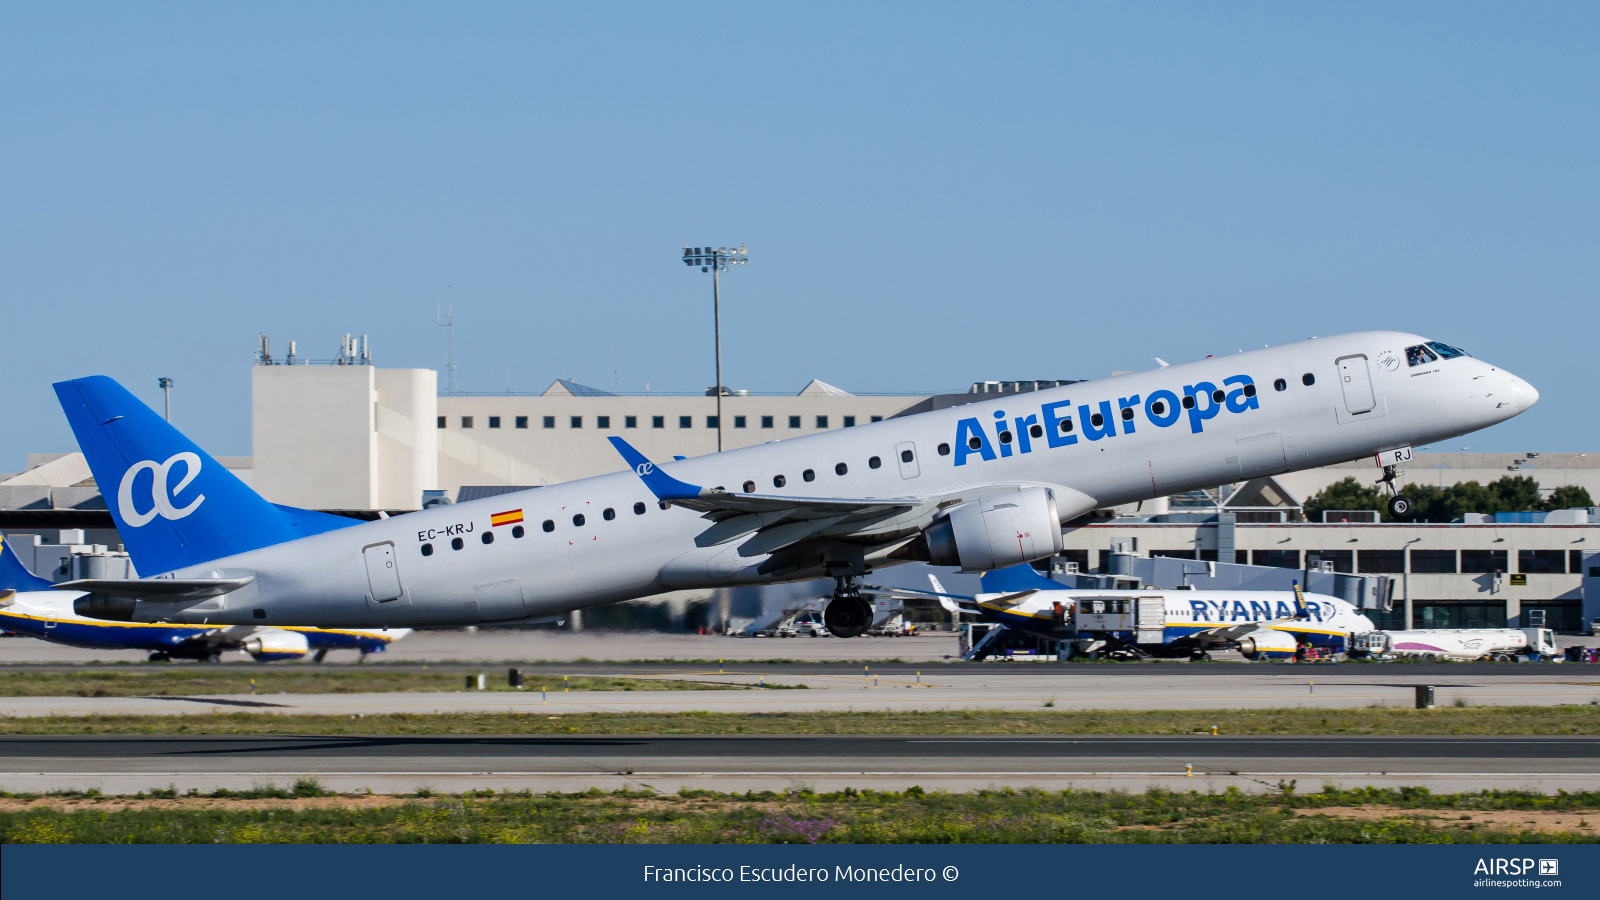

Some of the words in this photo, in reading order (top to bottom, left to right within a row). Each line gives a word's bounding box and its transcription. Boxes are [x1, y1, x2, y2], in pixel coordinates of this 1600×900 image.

[954, 374, 1259, 467] AirEuropa
[1394, 448, 1411, 462] RJ
[418, 521, 474, 542] EC-KRJ
[1190, 600, 1323, 622] RYANAR
